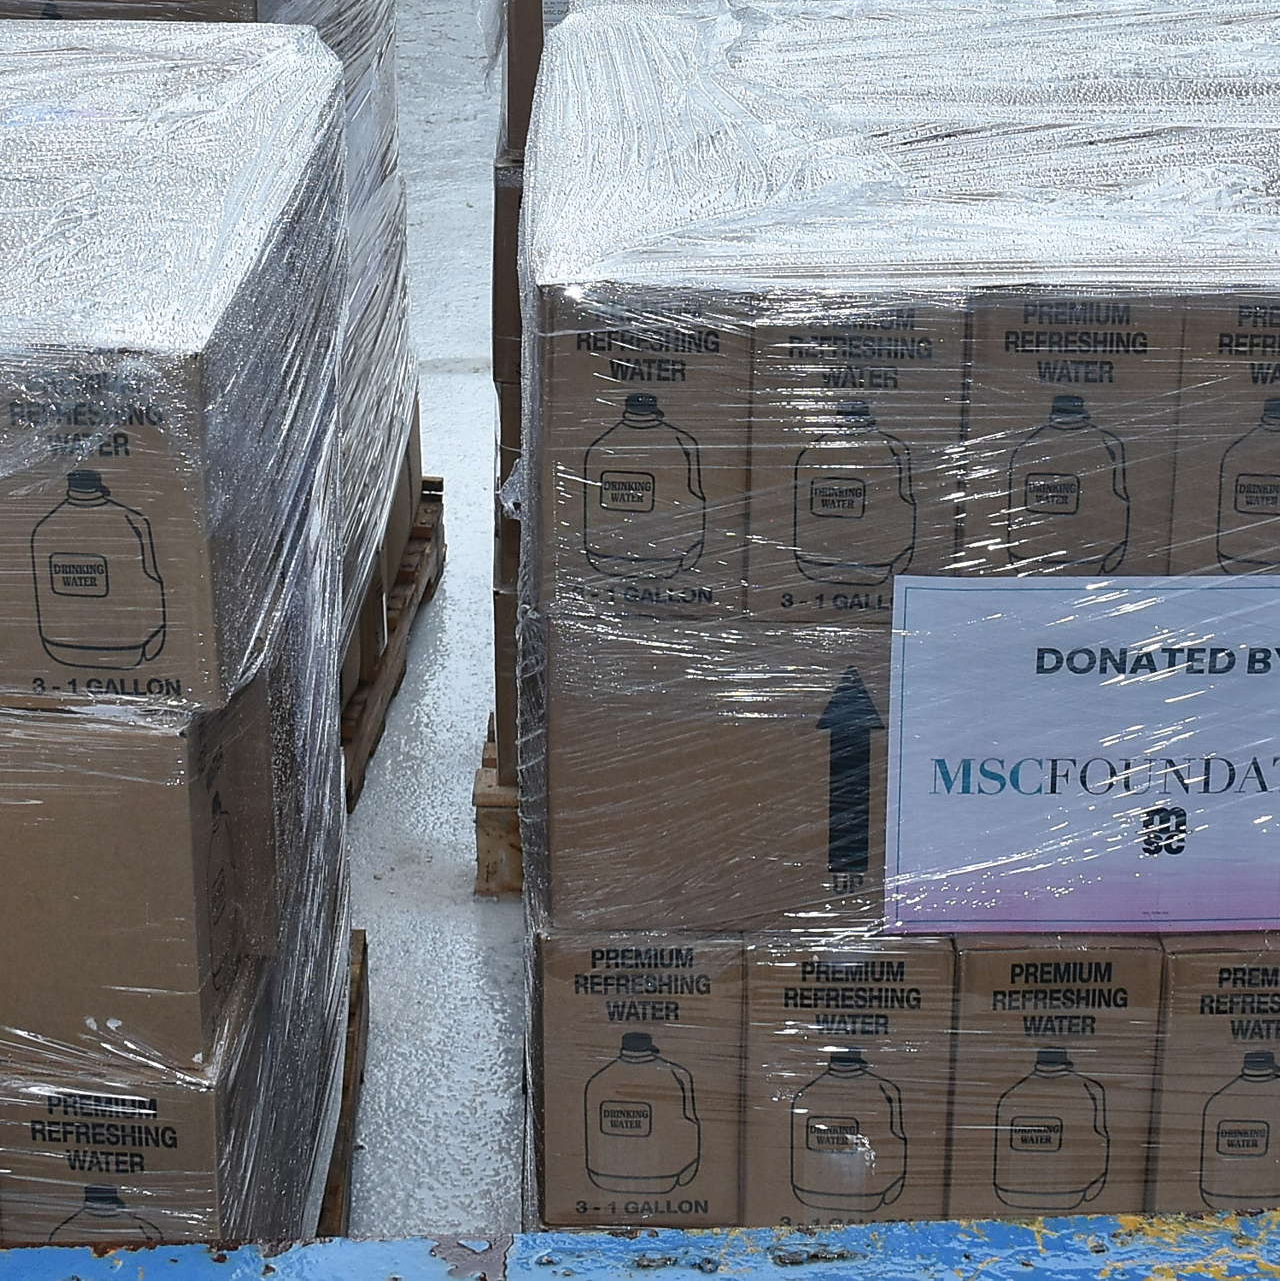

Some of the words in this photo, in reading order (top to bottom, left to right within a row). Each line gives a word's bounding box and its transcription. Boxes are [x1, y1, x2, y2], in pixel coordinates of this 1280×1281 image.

[1023, 302, 1131, 326] PREMIUM
[1004, 330, 1149, 355] REFRESHING
[608, 358, 687, 383] WATER
[1036, 359, 1115, 383] WATER
[53, 562, 105, 576] DRINKING
[61, 575, 98, 588] WATER
[1036, 646, 1236, 676] DONATED
[86, 677, 183, 698] GALLON
[590, 947, 695, 971] PREMIUM
[800, 960, 906, 984] PREMIUM
[1009, 961, 1114, 984] PREMIUM
[574, 973, 711, 996] REFRESHING
[783, 986, 921, 1010] REFRESHING
[991, 987, 1129, 1011] REFRESHING
[605, 1000, 680, 1022] WATER
[814, 1013, 890, 1036] WATER
[1022, 1013, 1097, 1037] WATER
[602, 1107, 650, 1122] DRINKING
[610, 1118, 643, 1131] WATER
[29, 1121, 178, 1149] REFRESHING
[1019, 1134, 1053, 1147] WATER
[1226, 1137, 1259, 1150] WATER
[64, 1149, 145, 1174] WATER
[575, 1197, 589, 1216] 3
[623, 1196, 710, 1216] GALLON
